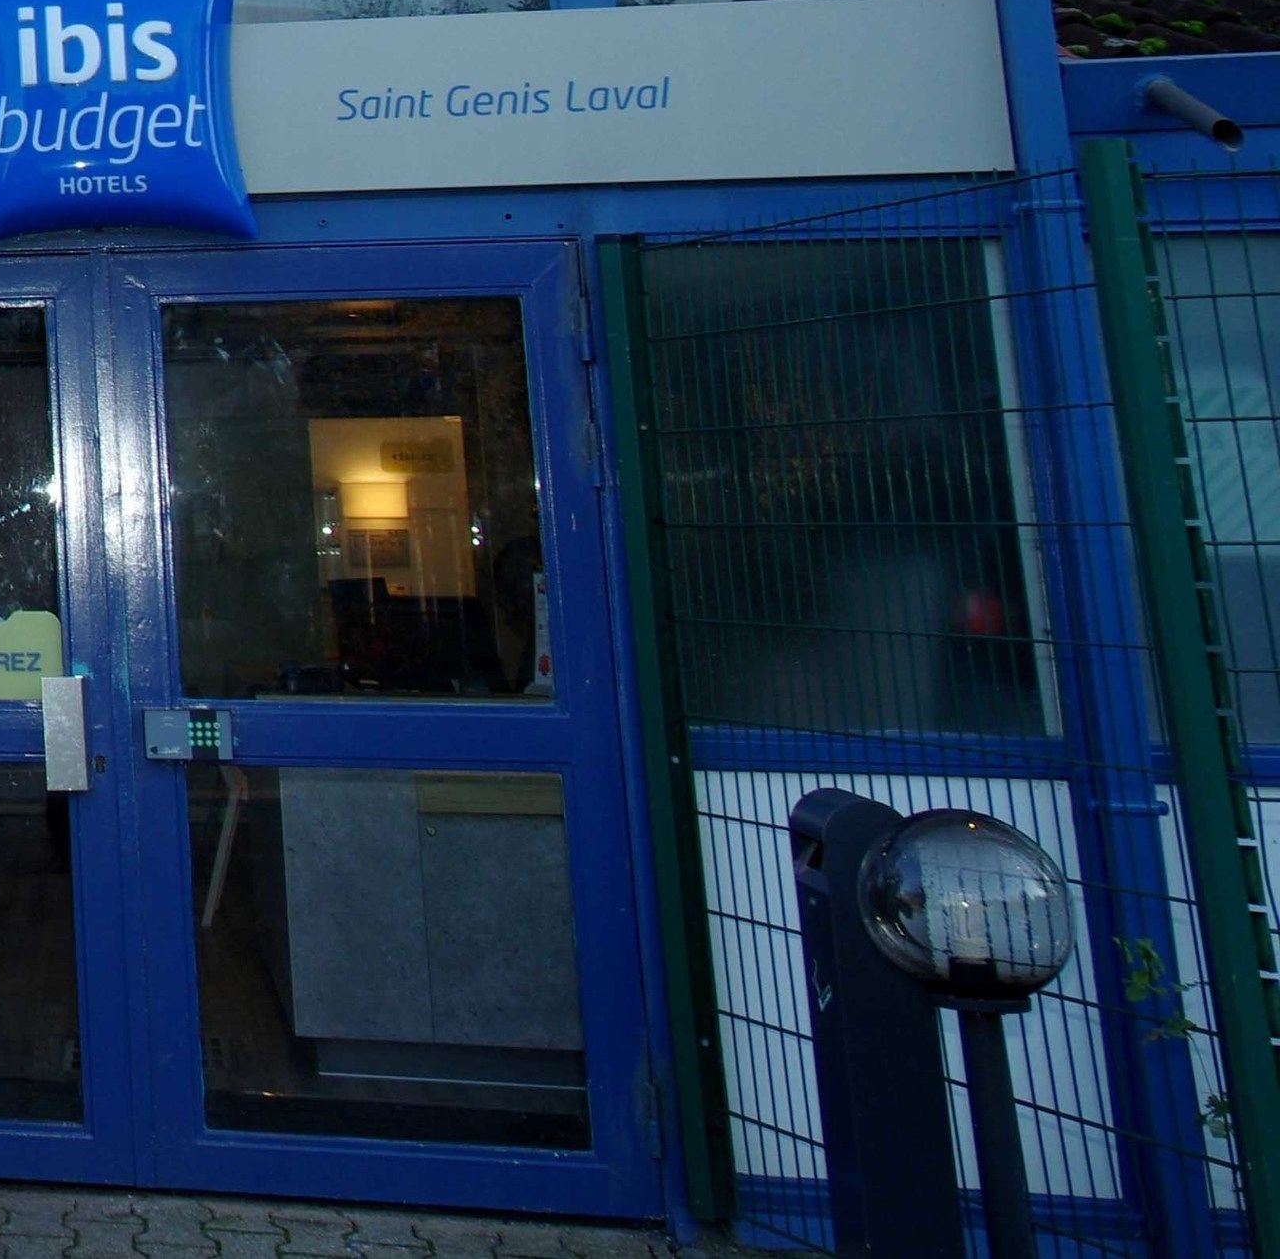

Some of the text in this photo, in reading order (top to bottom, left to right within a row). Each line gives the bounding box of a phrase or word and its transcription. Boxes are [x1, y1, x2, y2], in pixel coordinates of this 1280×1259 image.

[17, 2, 178, 88] ibis
[337, 76, 671, 121] Saint Genis Laval
[59, 174, 148, 195] HOTELS
